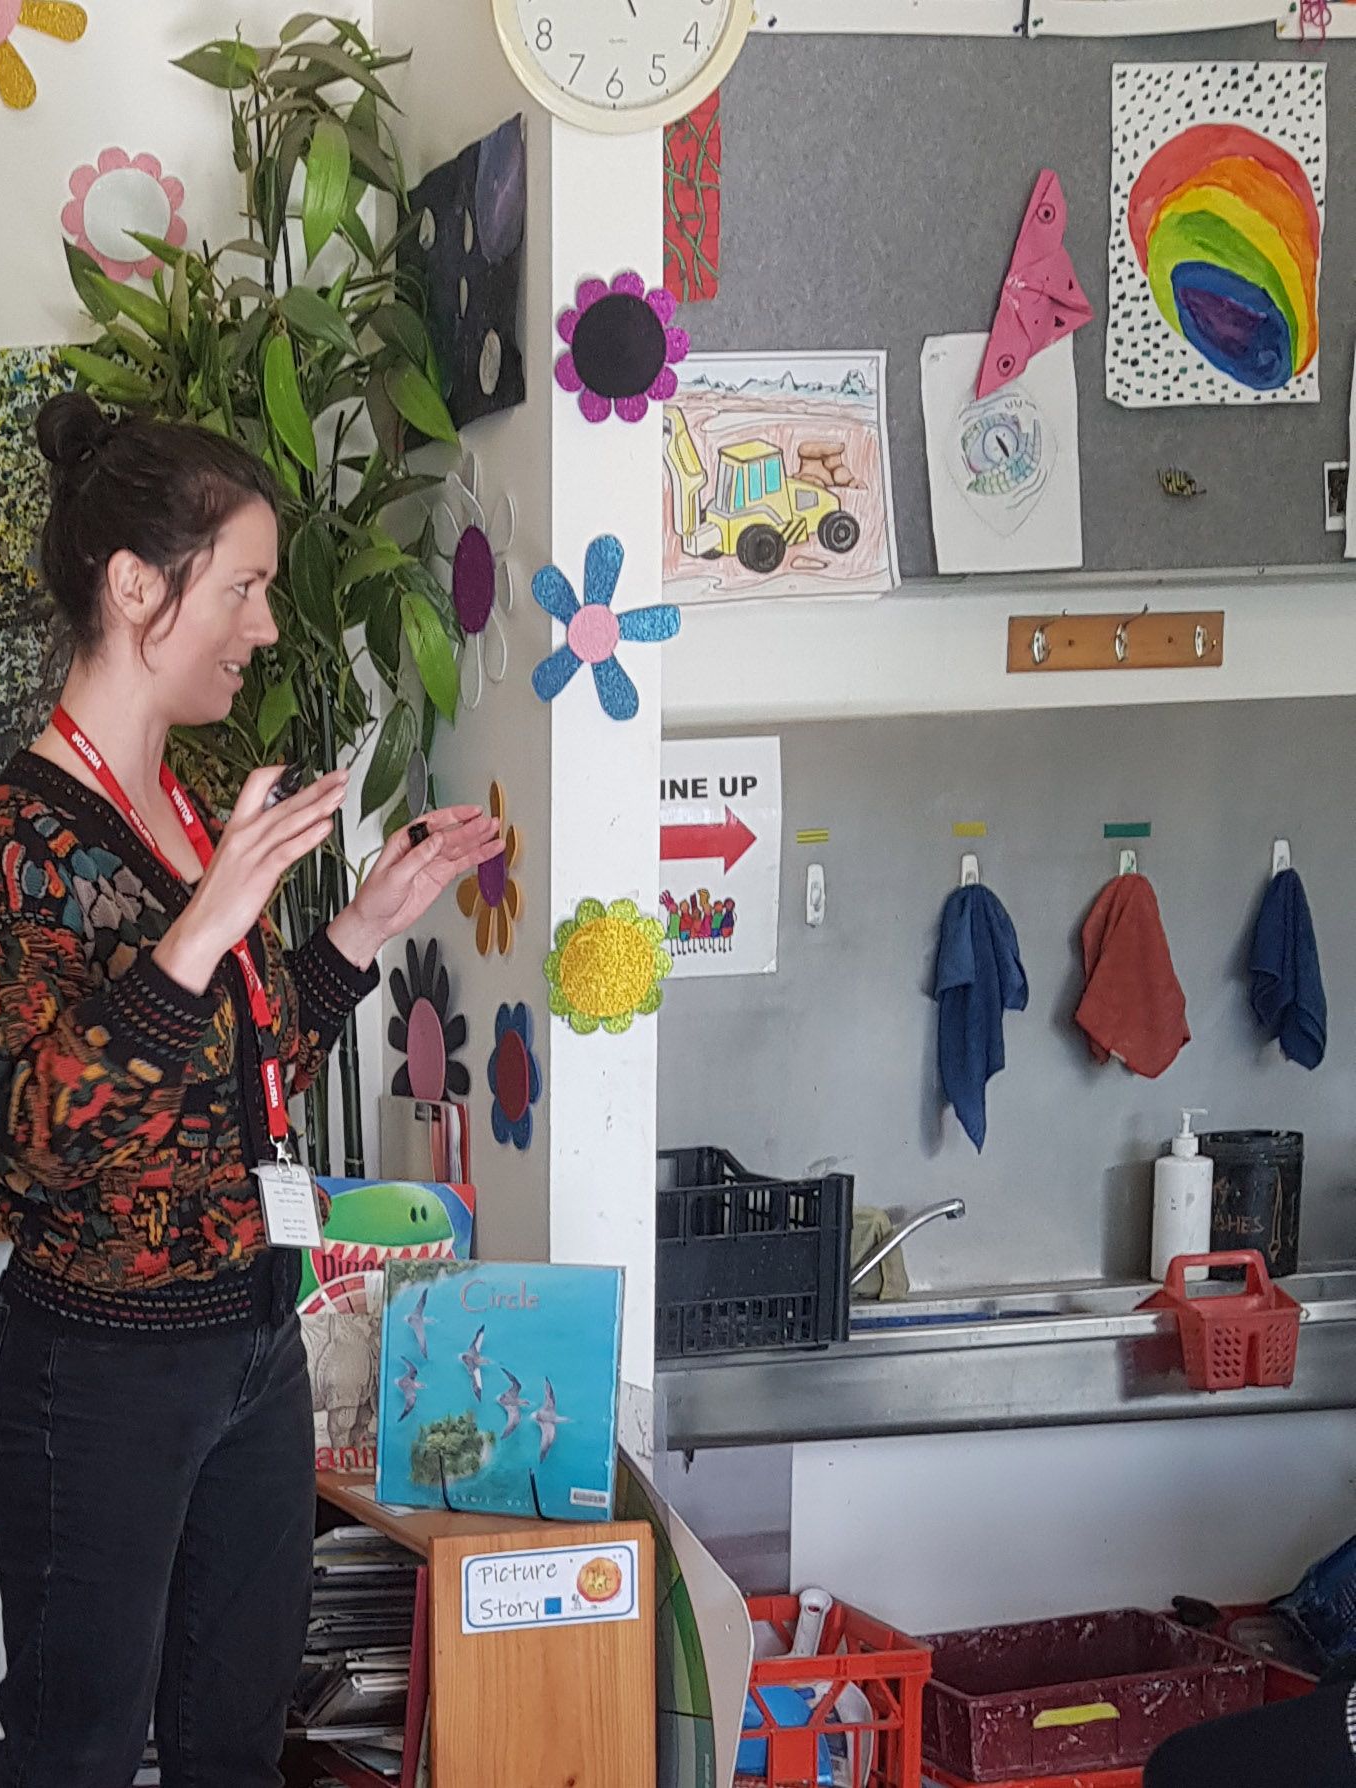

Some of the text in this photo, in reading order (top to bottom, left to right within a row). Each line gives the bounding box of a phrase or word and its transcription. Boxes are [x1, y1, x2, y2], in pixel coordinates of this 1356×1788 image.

[535, 18, 553, 51] 8
[683, 21, 701, 52] 4
[568, 53, 586, 85] 7
[605, 66, 624, 100] 6
[648, 54, 667, 87] 5
[71, 731, 103, 770] VISITOR
[719, 775, 758, 797] UP
[171, 786, 194, 826] VISITOR
[265, 1063, 278, 1108] VISITOR
[460, 1279, 541, 1314] Circle
[476, 1562, 559, 1586] Picture
[479, 1596, 540, 1621] Story
